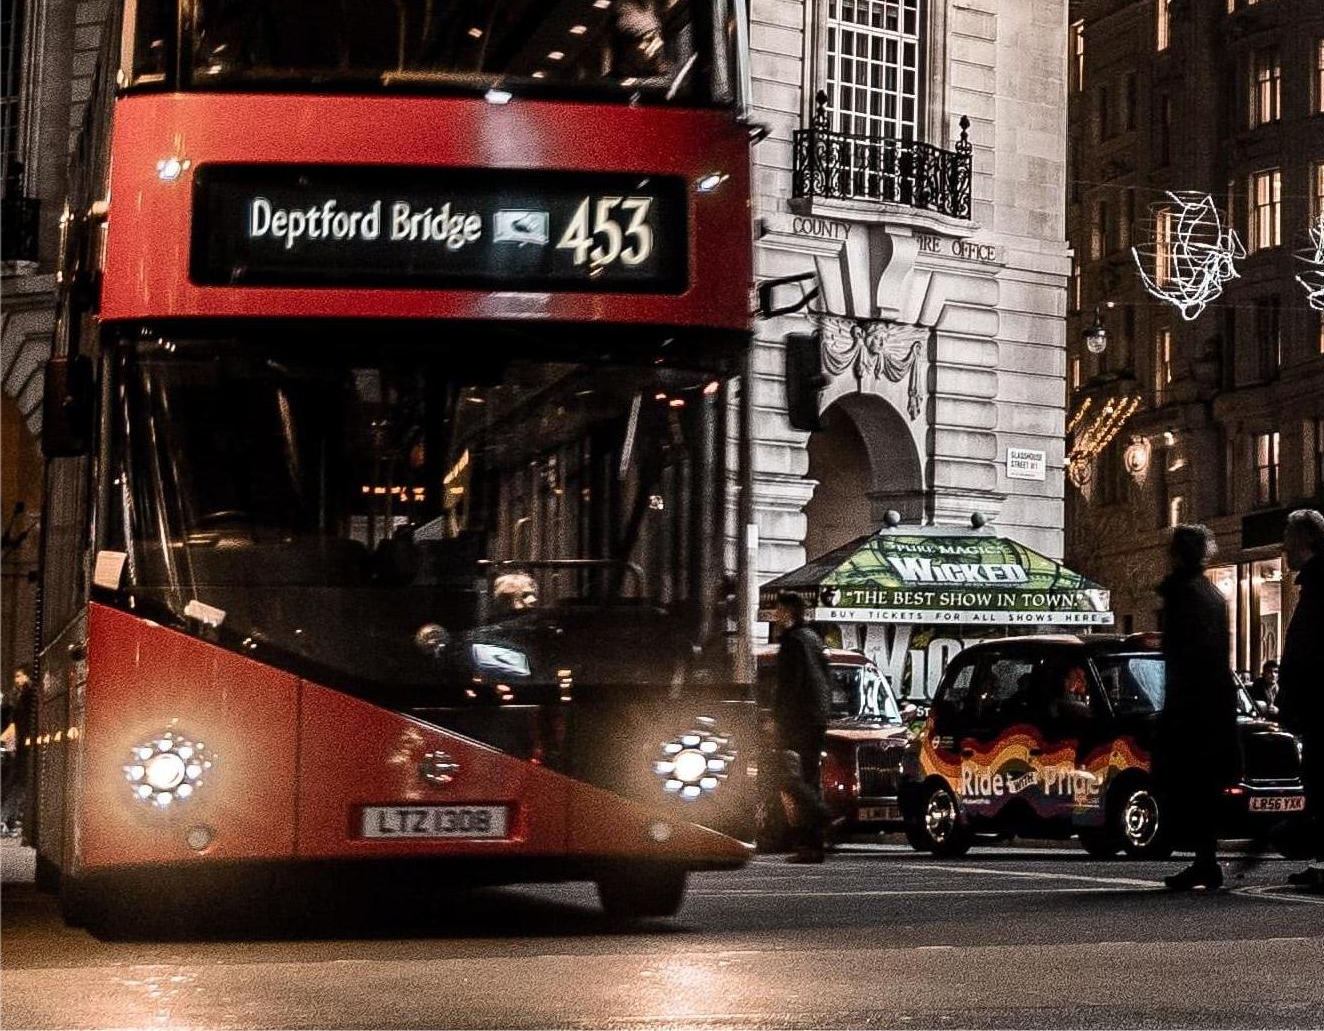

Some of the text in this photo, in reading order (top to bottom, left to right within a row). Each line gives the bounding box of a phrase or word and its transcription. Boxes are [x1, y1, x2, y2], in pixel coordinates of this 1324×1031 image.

[250, 196, 655, 267] Deptford Bridge 453
[792, 217, 851, 240] COUNTY
[952, 239, 996, 261] OFFICE
[1010, 461, 1029, 470] STREET
[893, 591, 935, 606] BEST
[940, 592, 992, 607] SHOW
[997, 593, 1016, 607] IN
[830, 611, 1097, 622] BUY TICKETS FOR ALL SHOWS HERE
[961, 765, 1004, 796] Ride
[1252, 798, 1282, 810] LR56
[379, 810, 428, 833] LTZ
